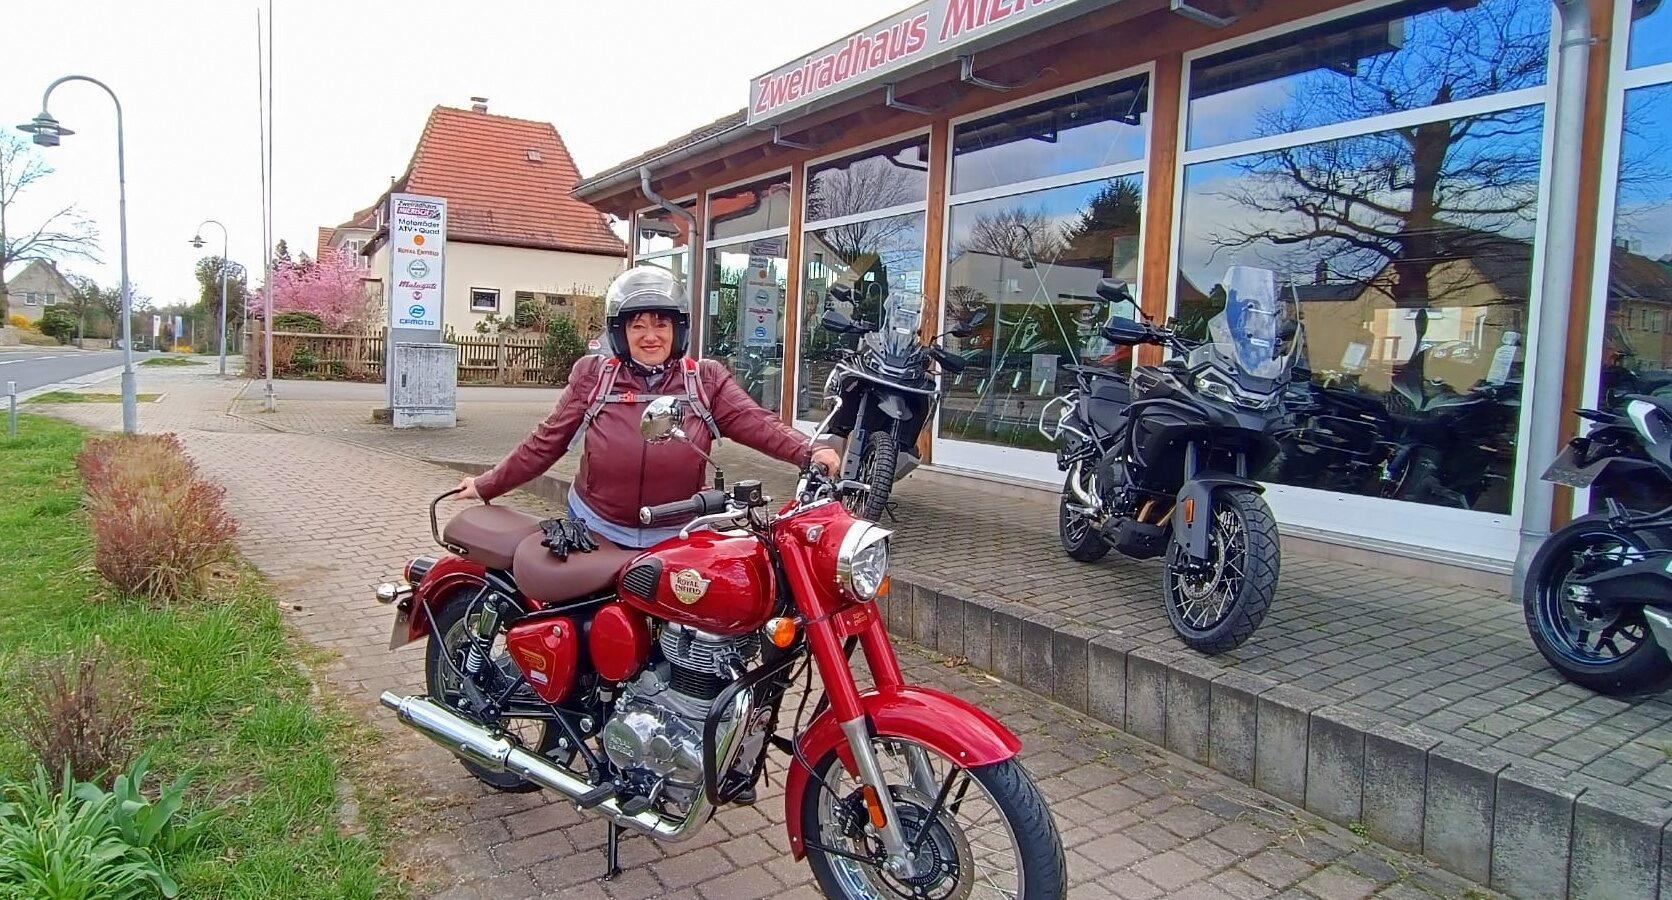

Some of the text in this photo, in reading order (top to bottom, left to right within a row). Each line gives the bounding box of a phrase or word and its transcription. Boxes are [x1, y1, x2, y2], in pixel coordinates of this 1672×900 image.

[754, 12, 929, 115] Zweiradhaus
[419, 227, 440, 235] Quad
[399, 318, 435, 326] CFMOTO
[676, 577, 700, 588] ROYAL
[675, 584, 702, 596] ENFIELD
